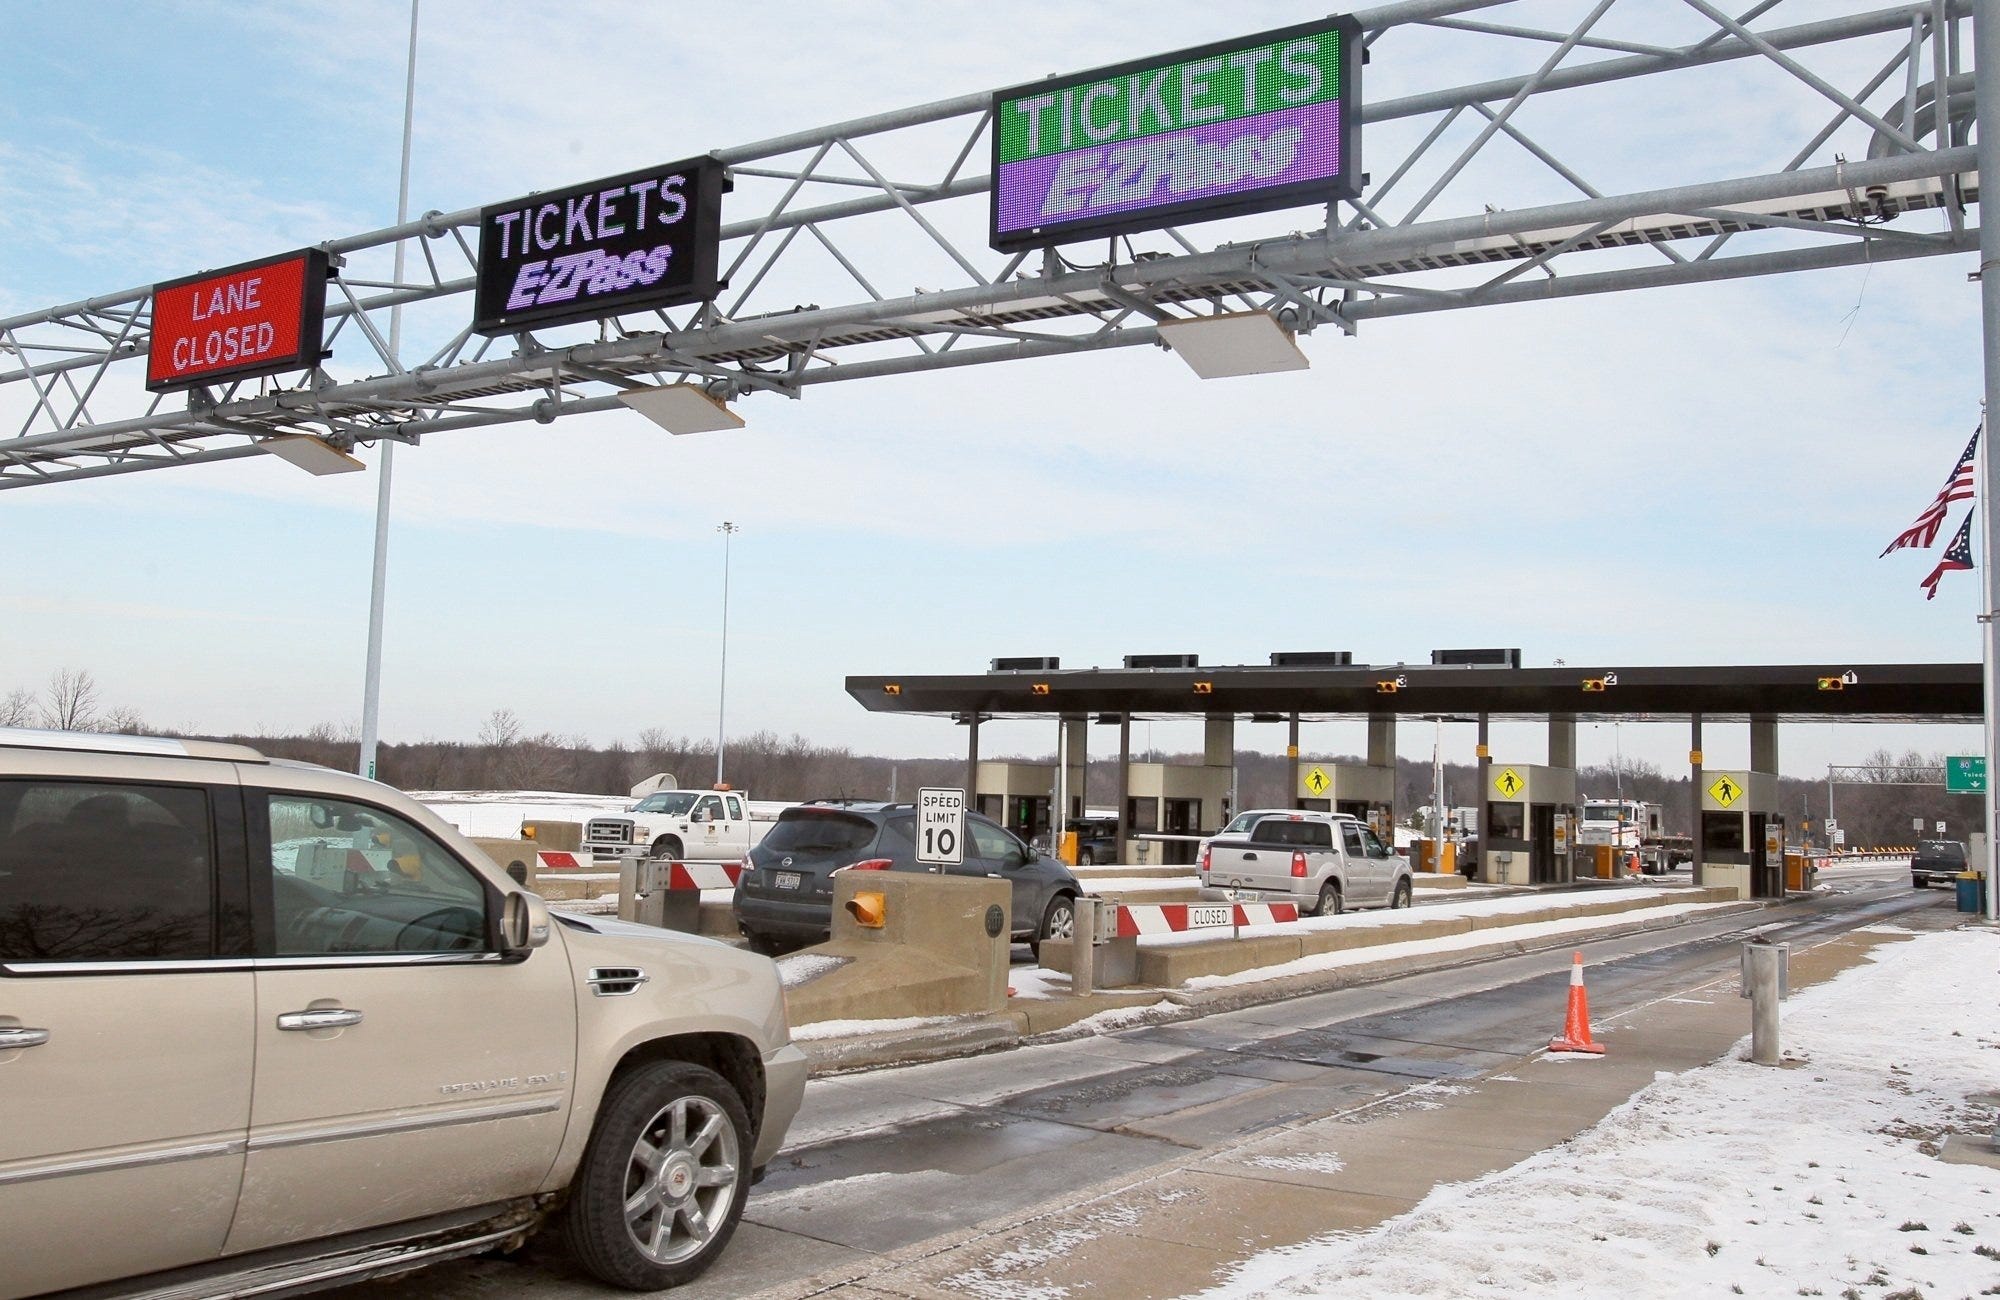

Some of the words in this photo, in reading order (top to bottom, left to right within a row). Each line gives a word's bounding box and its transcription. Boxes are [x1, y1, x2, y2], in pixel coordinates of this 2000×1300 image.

[1016, 38, 1324, 154] TICKETS
[495, 174, 687, 258] TICKETS
[192, 277, 262, 321] LANE
[173, 321, 275, 371] CLOSED
[923, 796, 961, 808] SPEED
[926, 812, 956, 824] LIMIT
[925, 827, 956, 856] 10
[1194, 909, 1228, 925] CLOSED
